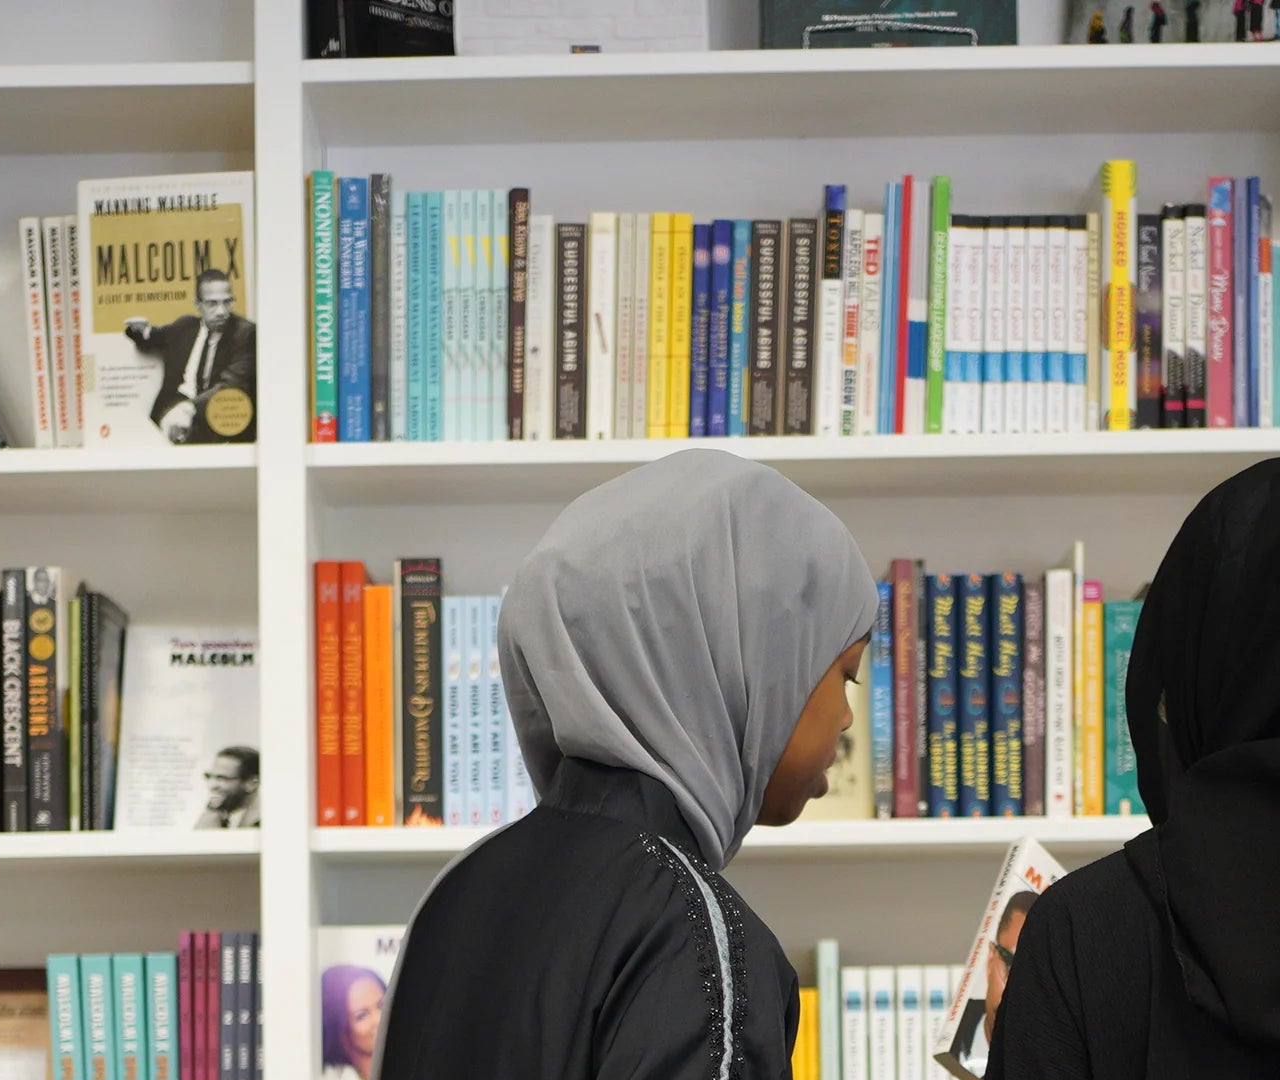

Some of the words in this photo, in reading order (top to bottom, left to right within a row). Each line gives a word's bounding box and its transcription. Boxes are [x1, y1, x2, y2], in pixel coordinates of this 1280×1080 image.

[26, 228, 35, 278] MALCOLM
[96, 239, 212, 285] MALCOLM
[225, 238, 240, 279] X
[316, 191, 333, 297] NONPROFIT
[866, 237, 880, 275] TED
[1114, 211, 1126, 267] HOOKED
[562, 241, 576, 325] SUCCESSFUL
[759, 238, 774, 322] SUCCESSFUL
[863, 279, 879, 331] TALKS
[316, 302, 334, 384] TOOLKIT
[563, 331, 576, 371] AGING
[757, 328, 771, 369] AGING
[1115, 350, 1126, 387] MOSS
[934, 596, 954, 637] Matt
[965, 596, 985, 637] Matt
[4, 619, 21, 676] BLACK
[169, 652, 254, 666] MALCOLM
[4, 677, 23, 767] CRESCENT
[28, 664, 48, 736] ARISING
[929, 733, 943, 787] LIBRARY
[945, 740, 958, 800] MIDNIGHT
[961, 732, 974, 787] LIBRARY
